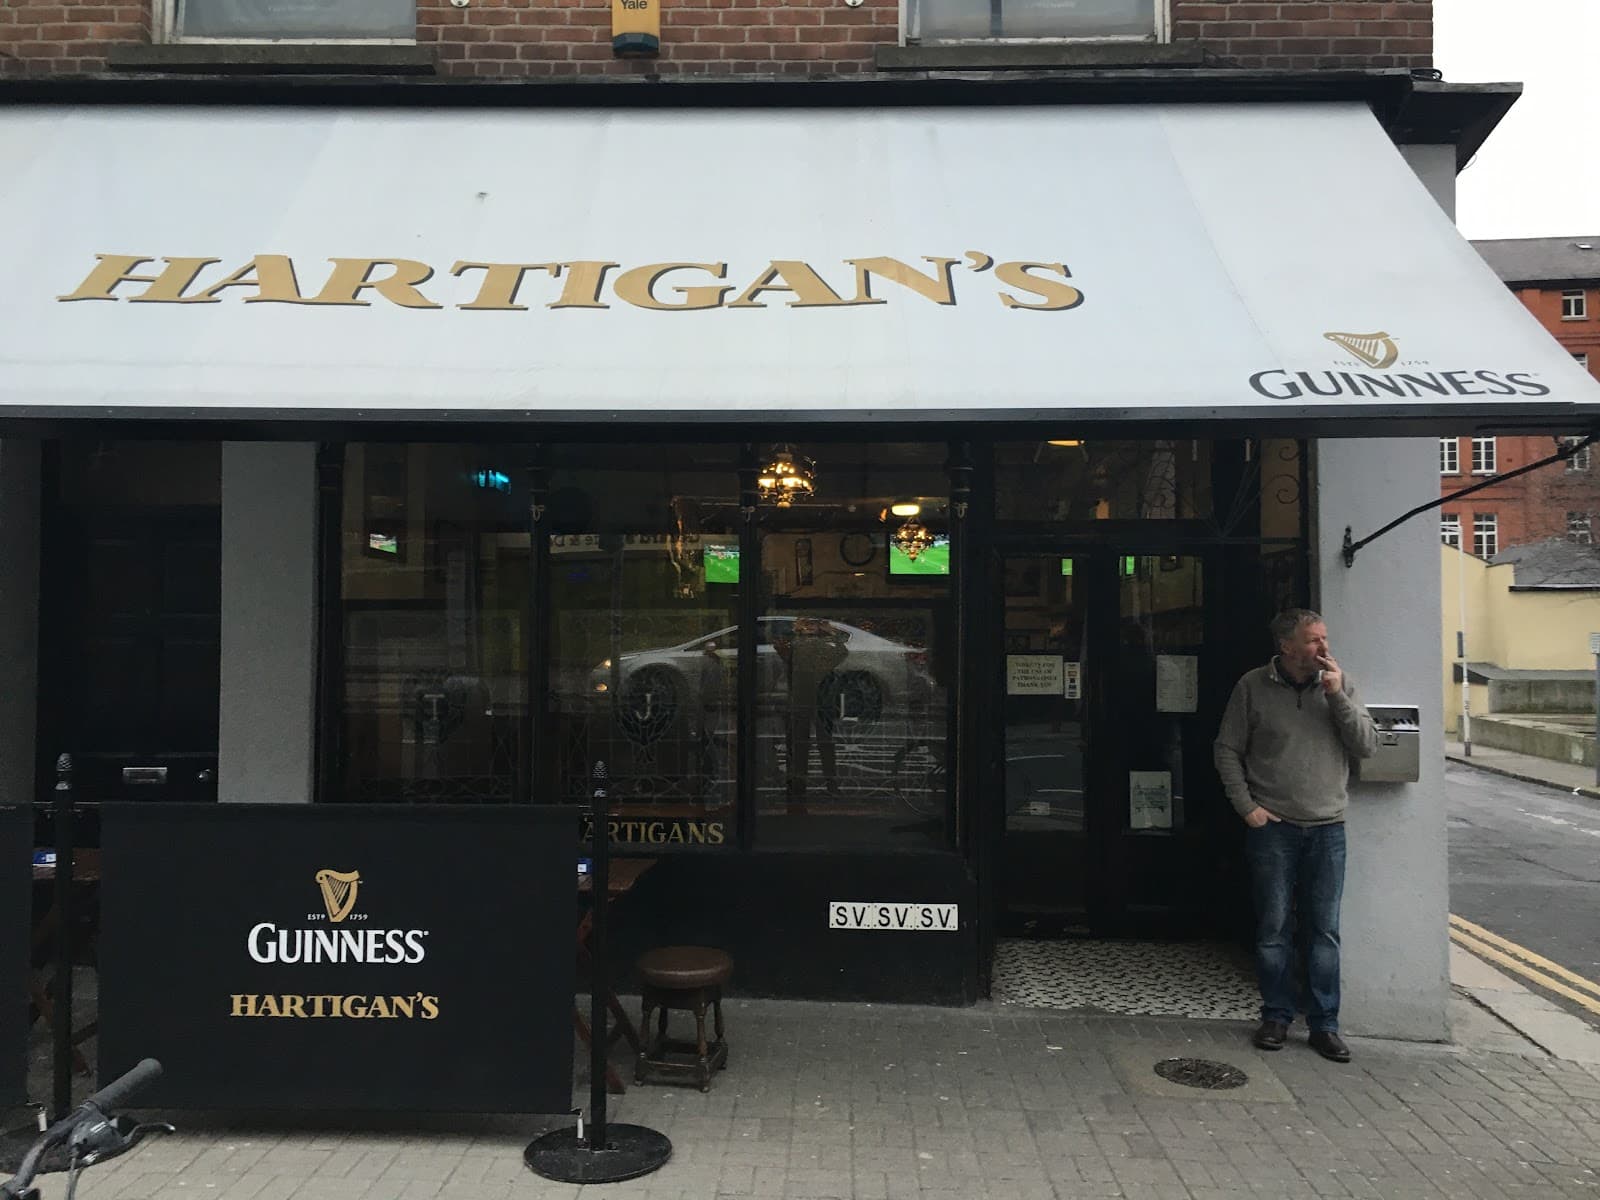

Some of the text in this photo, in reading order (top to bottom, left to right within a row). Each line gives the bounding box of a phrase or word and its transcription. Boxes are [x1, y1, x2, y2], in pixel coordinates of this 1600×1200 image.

[621, 0, 648, 10] Yale
[57, 250, 1085, 312] HARTIGAN'S
[1248, 368, 1550, 399] GUINNESS
[582, 821, 725, 845] ARTIGANS
[247, 921, 426, 964] GUINNESS
[230, 991, 440, 1020] HARTIGAN'S
